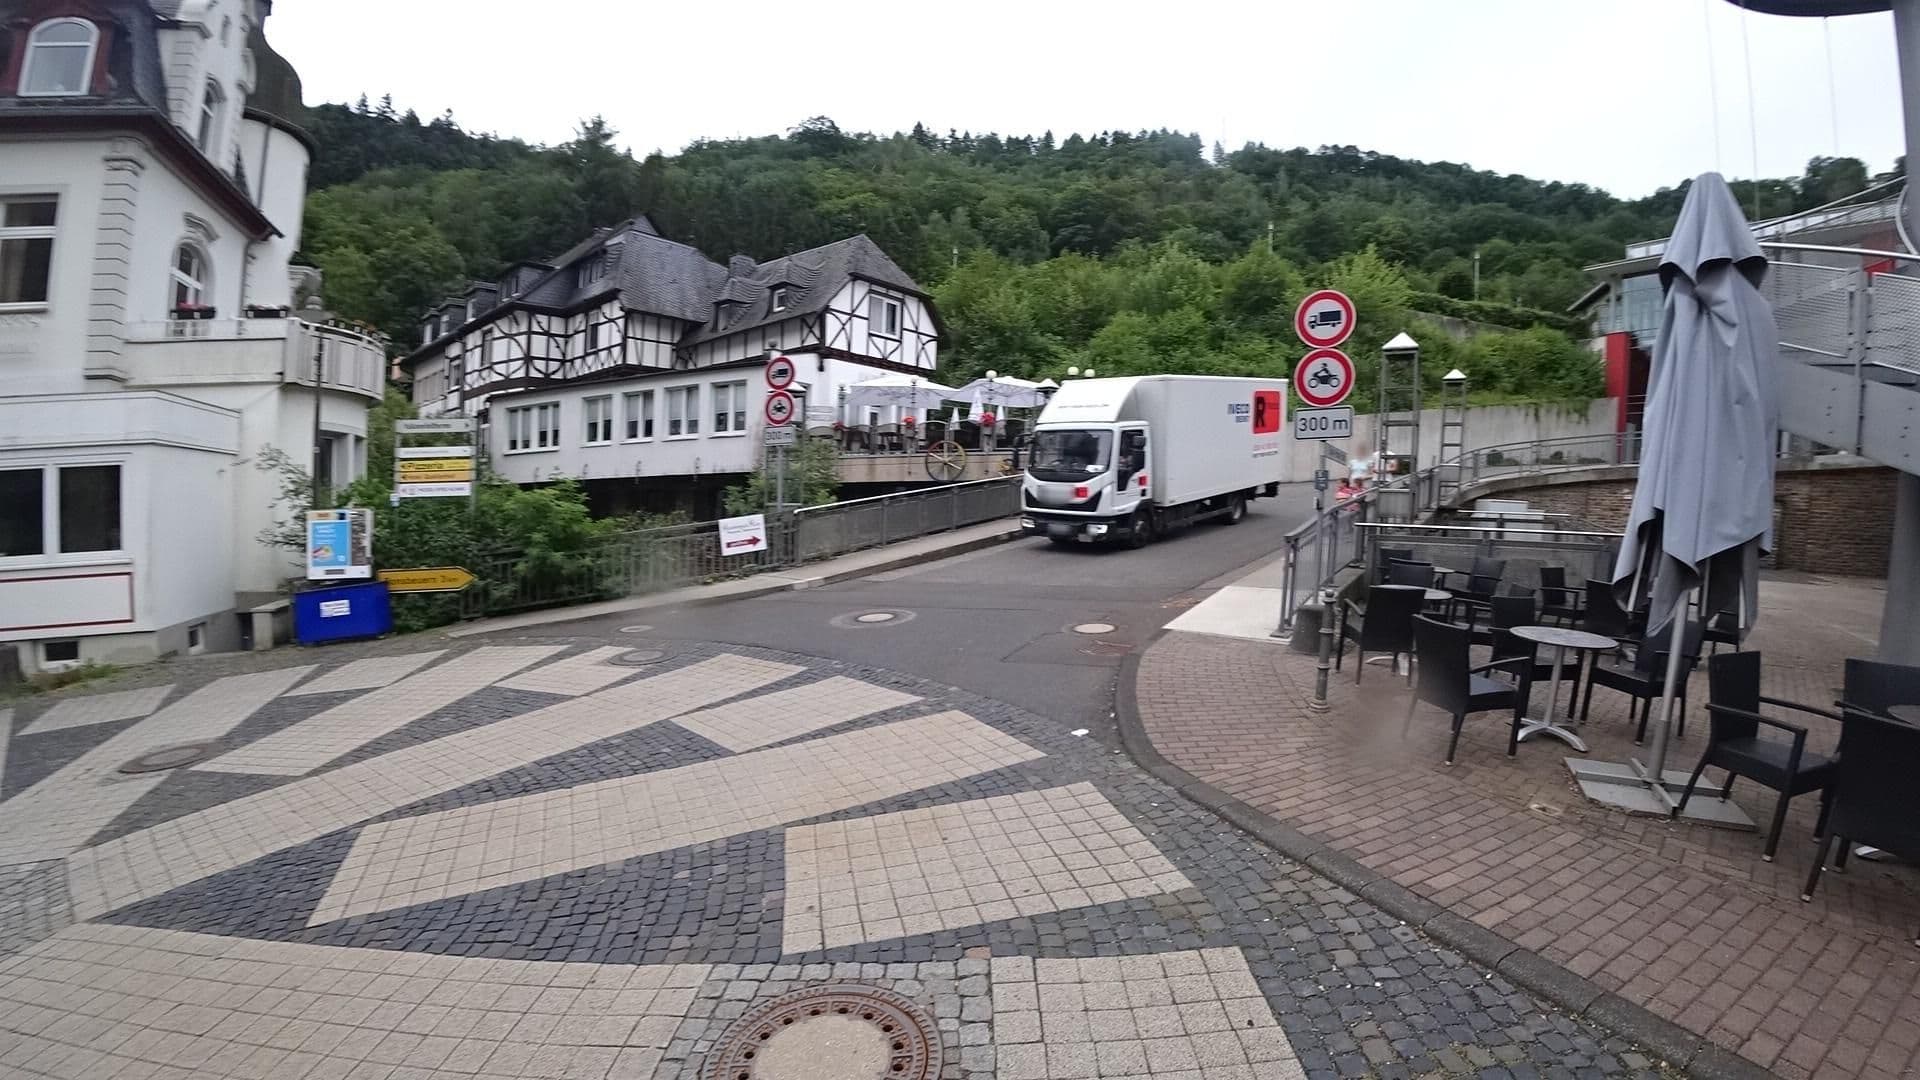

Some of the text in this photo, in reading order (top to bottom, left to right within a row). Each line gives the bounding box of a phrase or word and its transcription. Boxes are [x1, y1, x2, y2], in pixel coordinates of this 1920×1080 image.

[1227, 403, 1250, 414] IVECO
[1299, 416, 1349, 431] 300 m
